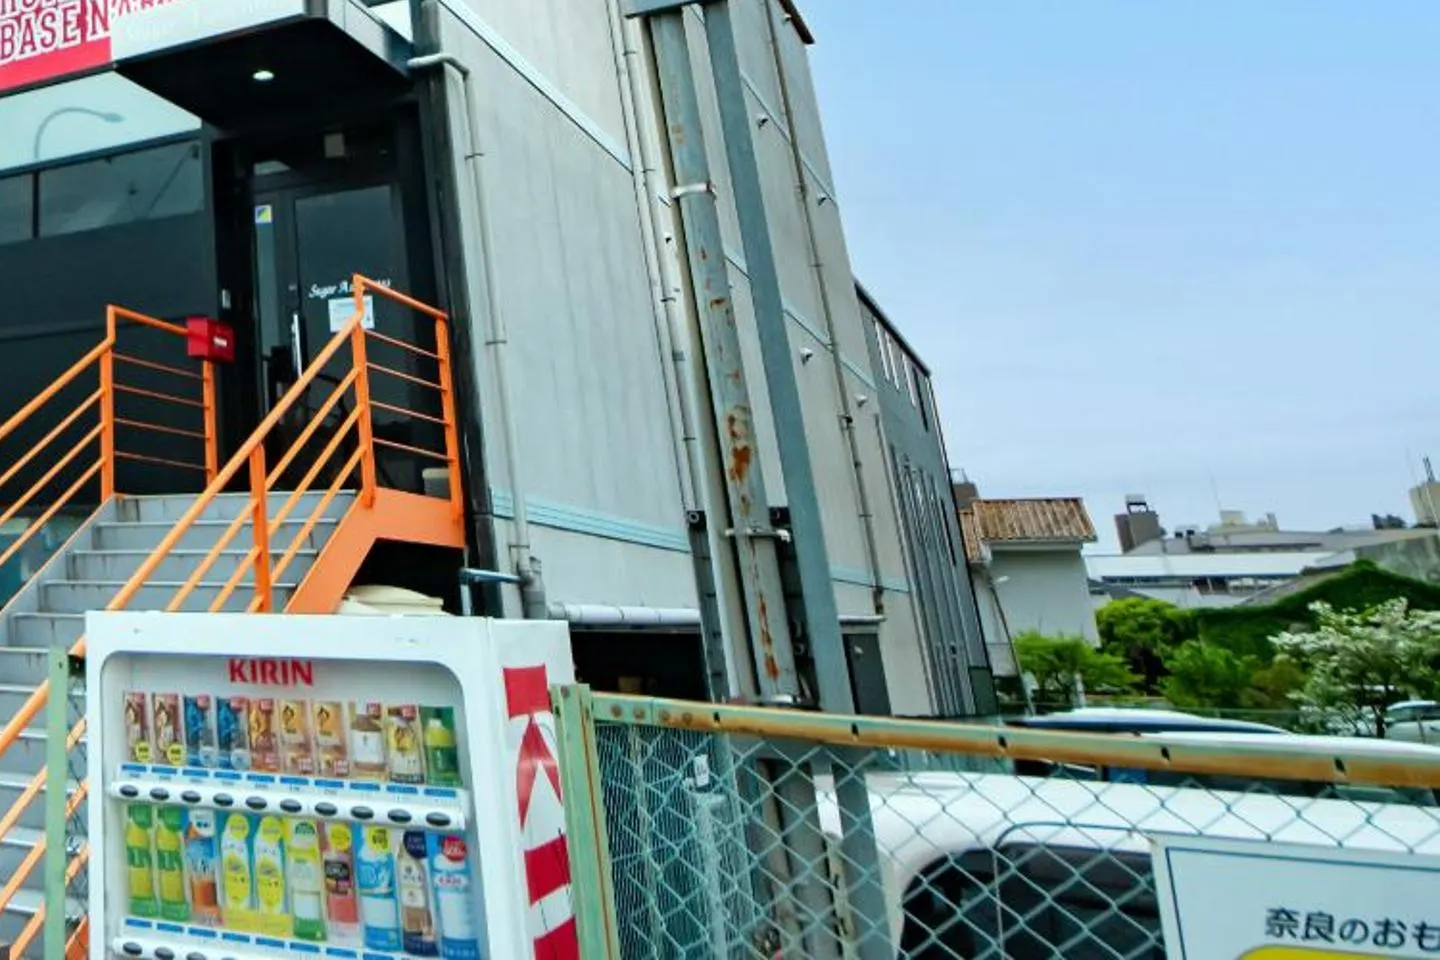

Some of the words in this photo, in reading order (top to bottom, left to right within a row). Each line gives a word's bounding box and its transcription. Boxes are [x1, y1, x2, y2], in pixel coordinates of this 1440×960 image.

[228, 658, 314, 686] KIRIN
[1265, 908, 1440, 951] 奈良のおも
